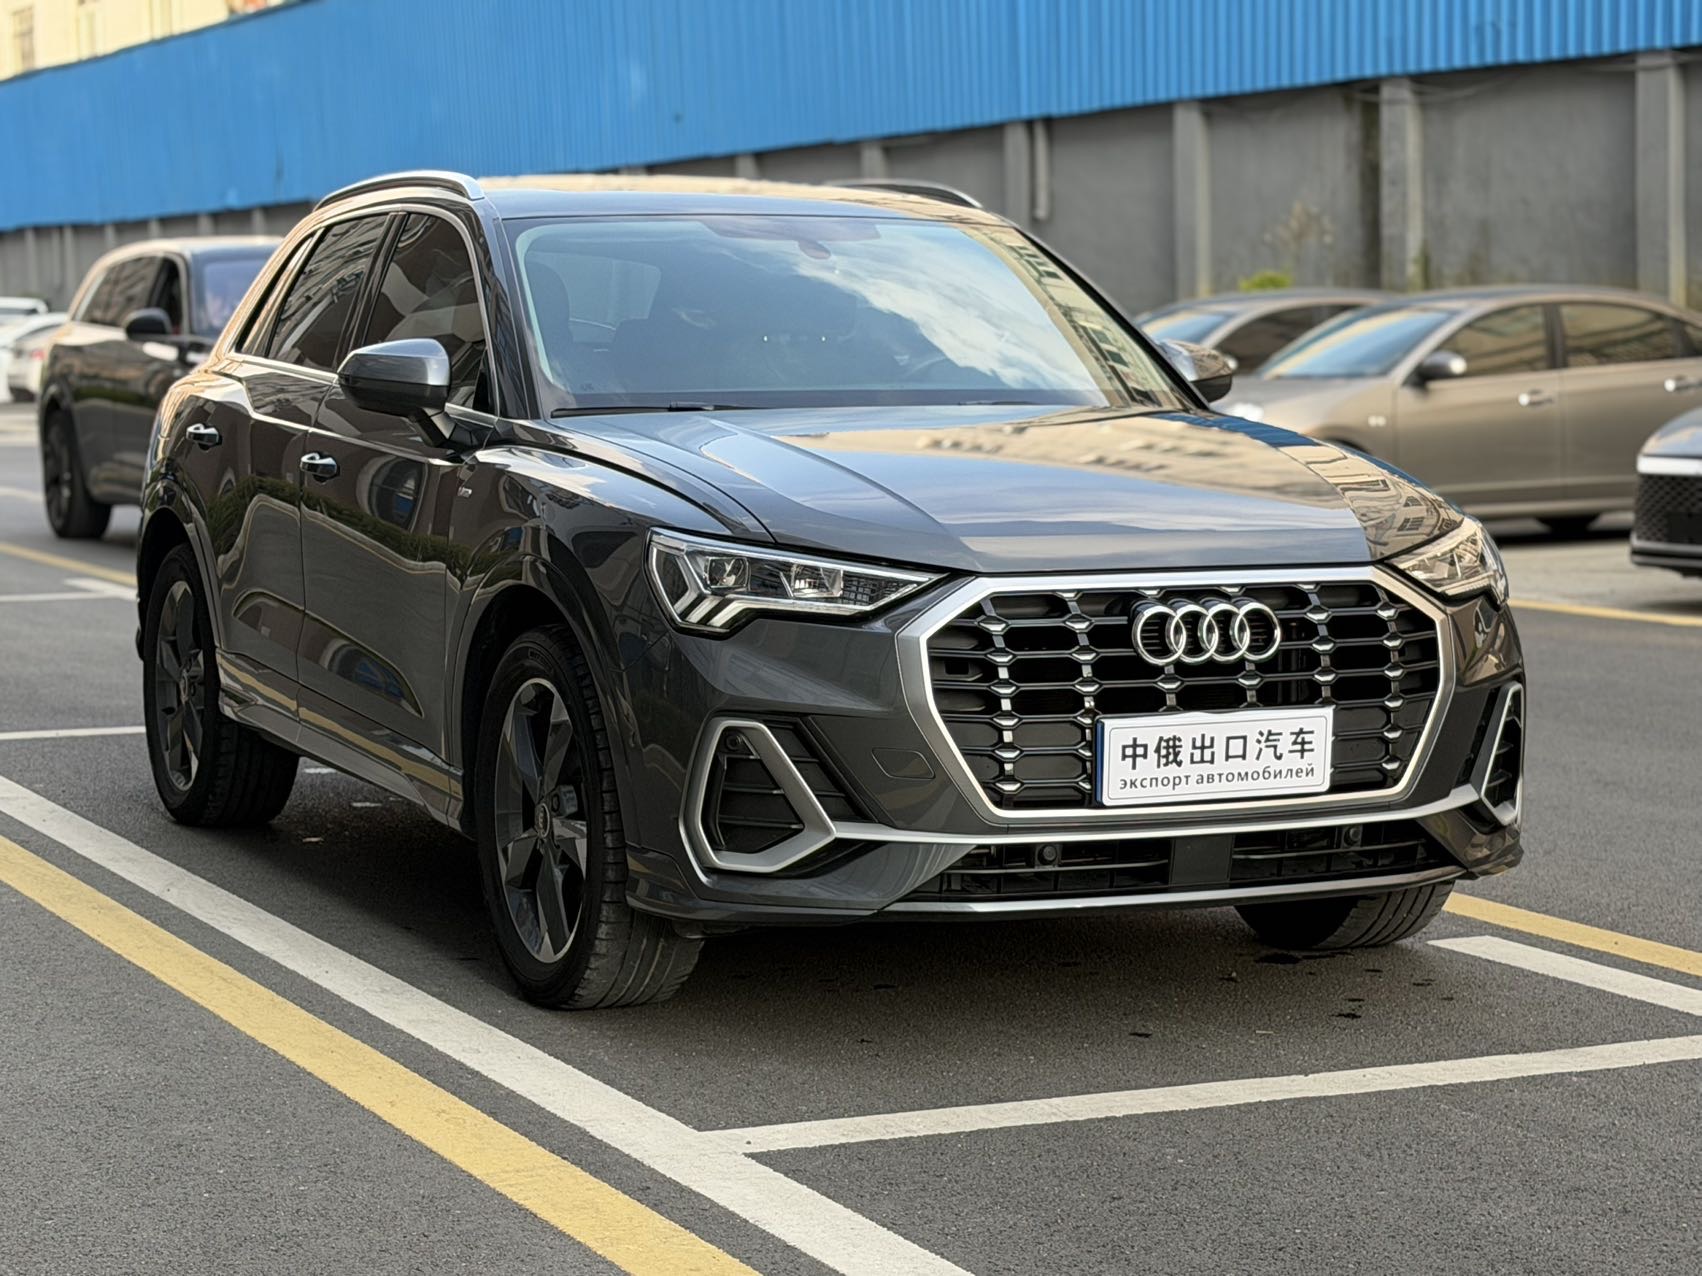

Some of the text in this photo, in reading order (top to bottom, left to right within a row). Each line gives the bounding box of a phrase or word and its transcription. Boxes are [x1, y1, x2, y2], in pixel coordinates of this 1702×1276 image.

[1120, 727, 1315, 770] 中俄出口汽车
[1119, 763, 1315, 790] экспорт автомобилей
